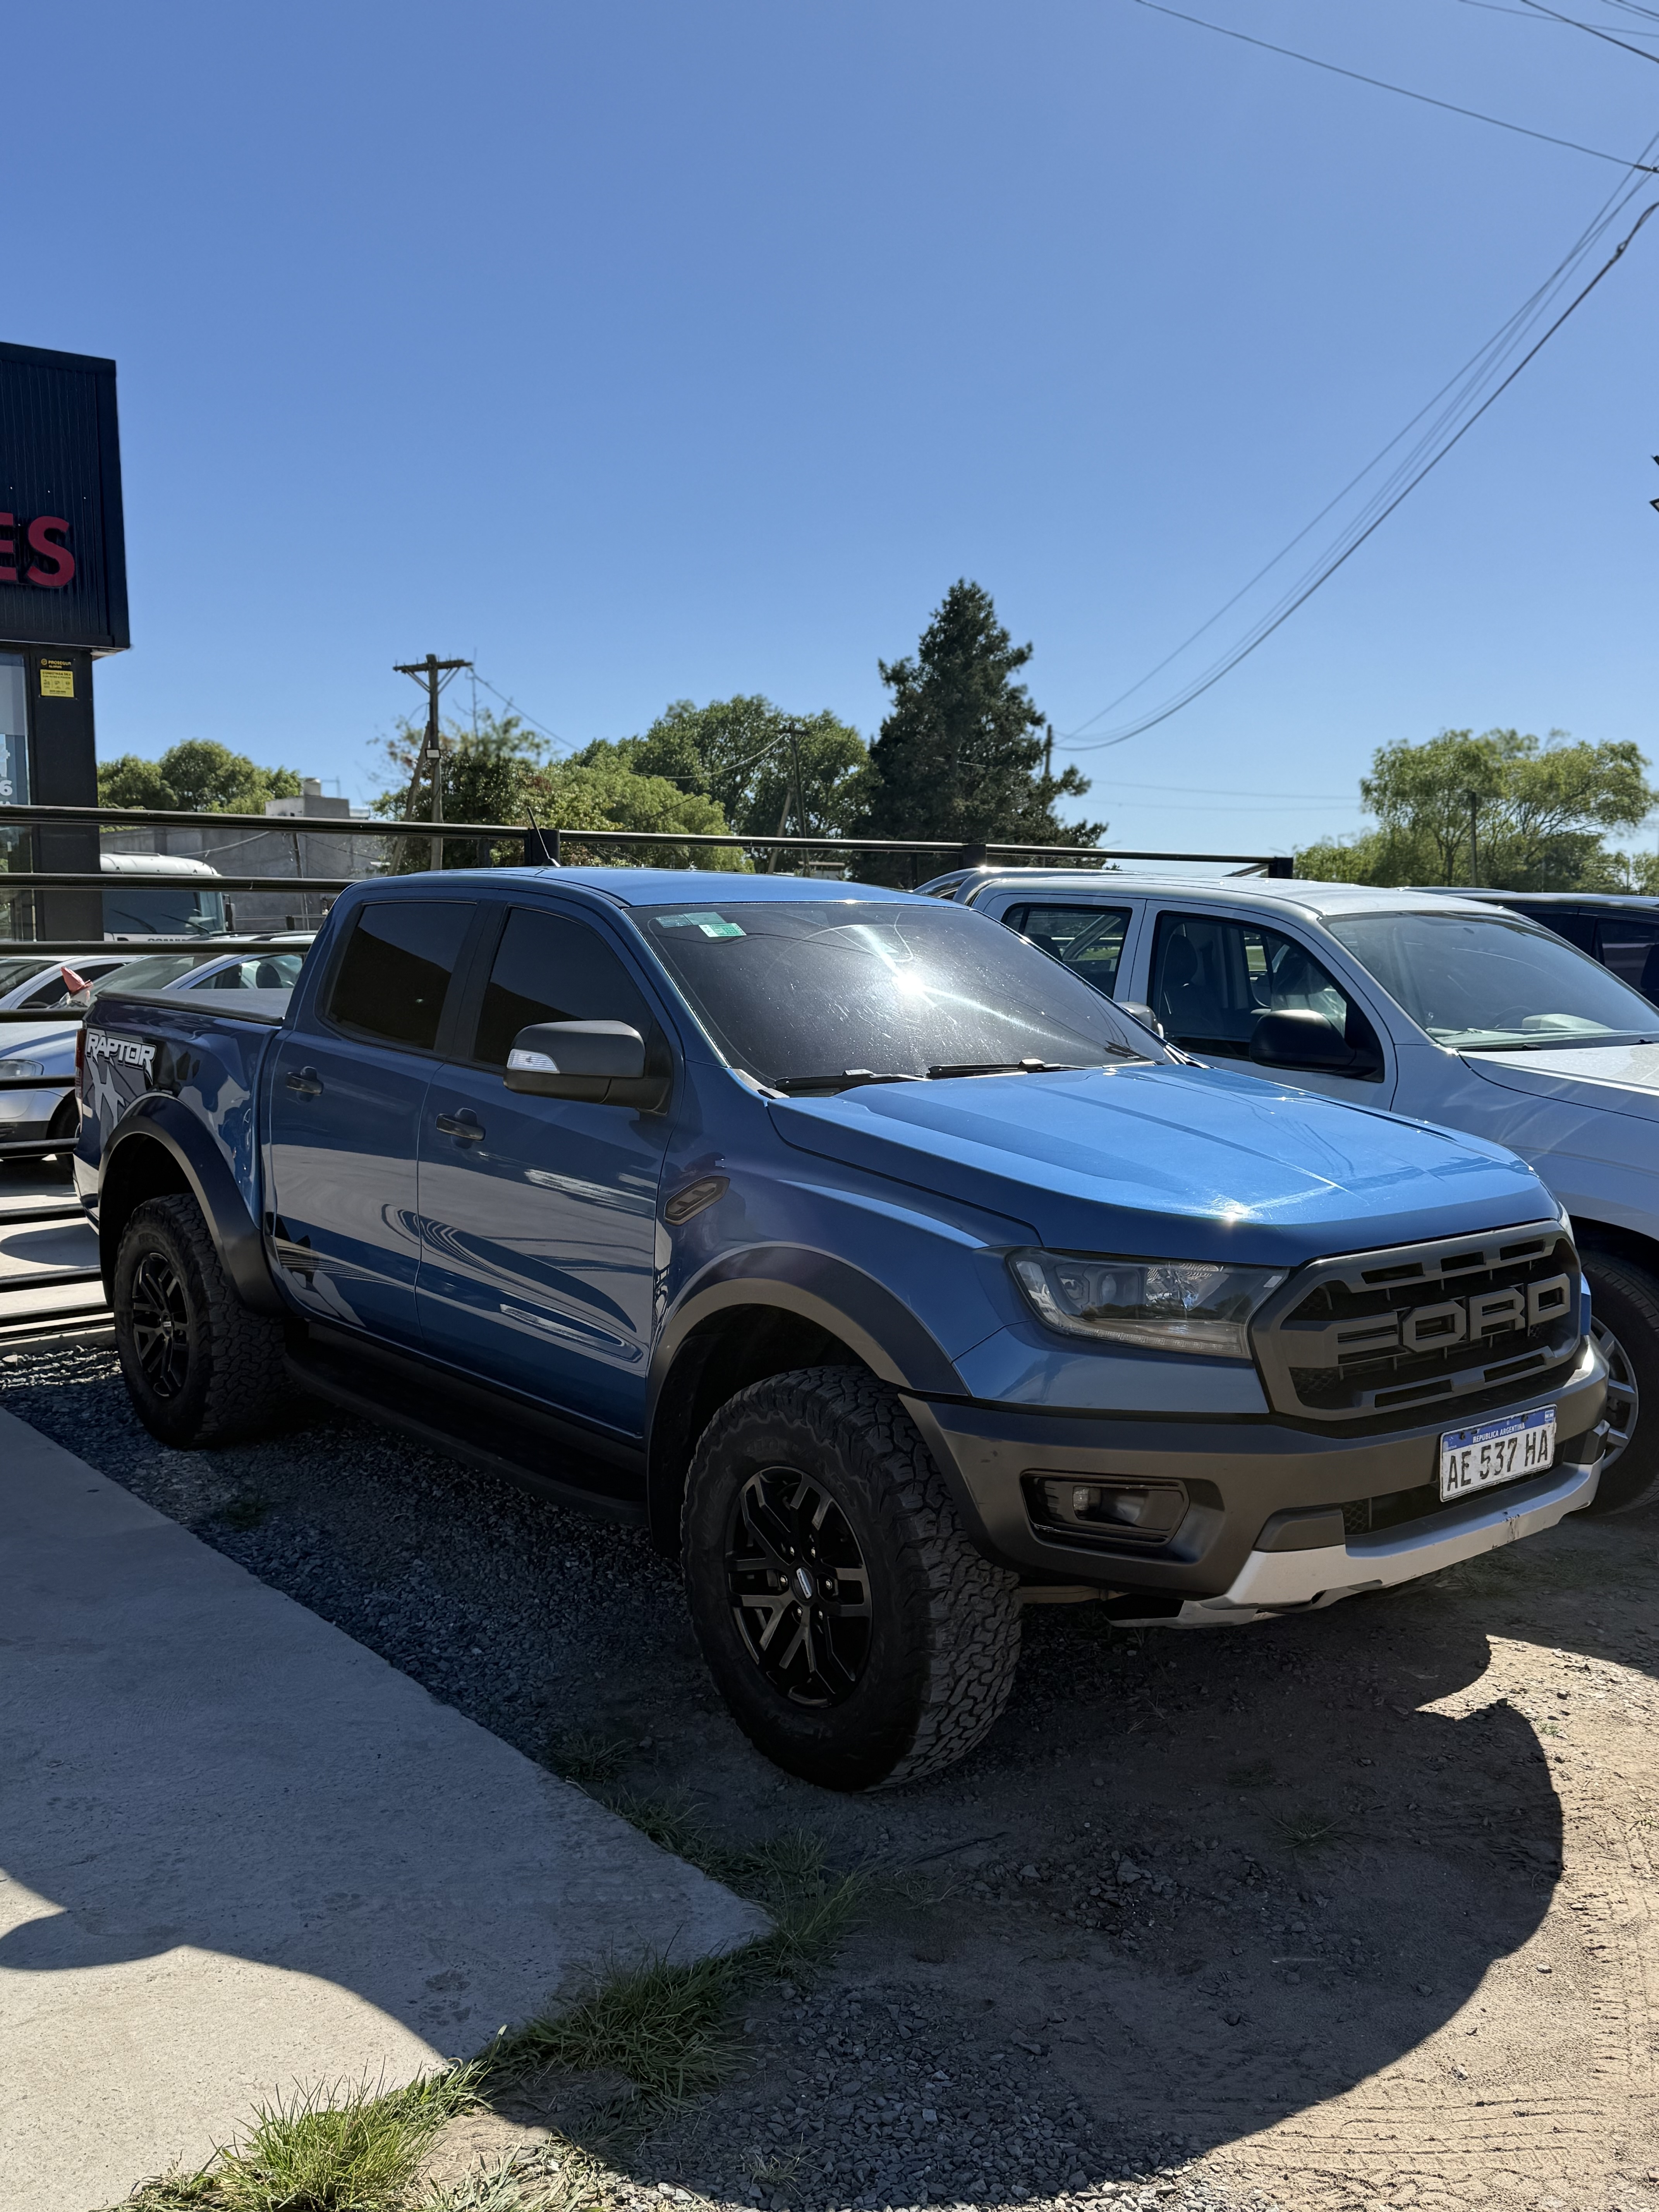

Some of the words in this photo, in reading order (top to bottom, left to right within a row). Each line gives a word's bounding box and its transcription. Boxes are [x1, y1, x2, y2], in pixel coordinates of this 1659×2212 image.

[87, 1033, 156, 1080] RAPTOR
[1319, 1273, 1571, 1368] FORD
[1473, 1431, 1499, 1443] REPUBLICA
[1500, 1422, 1525, 1436] ARGENTINA
[1447, 1450, 1471, 1491] AE
[1480, 1437, 1518, 1479] 537
[1525, 1429, 1547, 1467] HA
